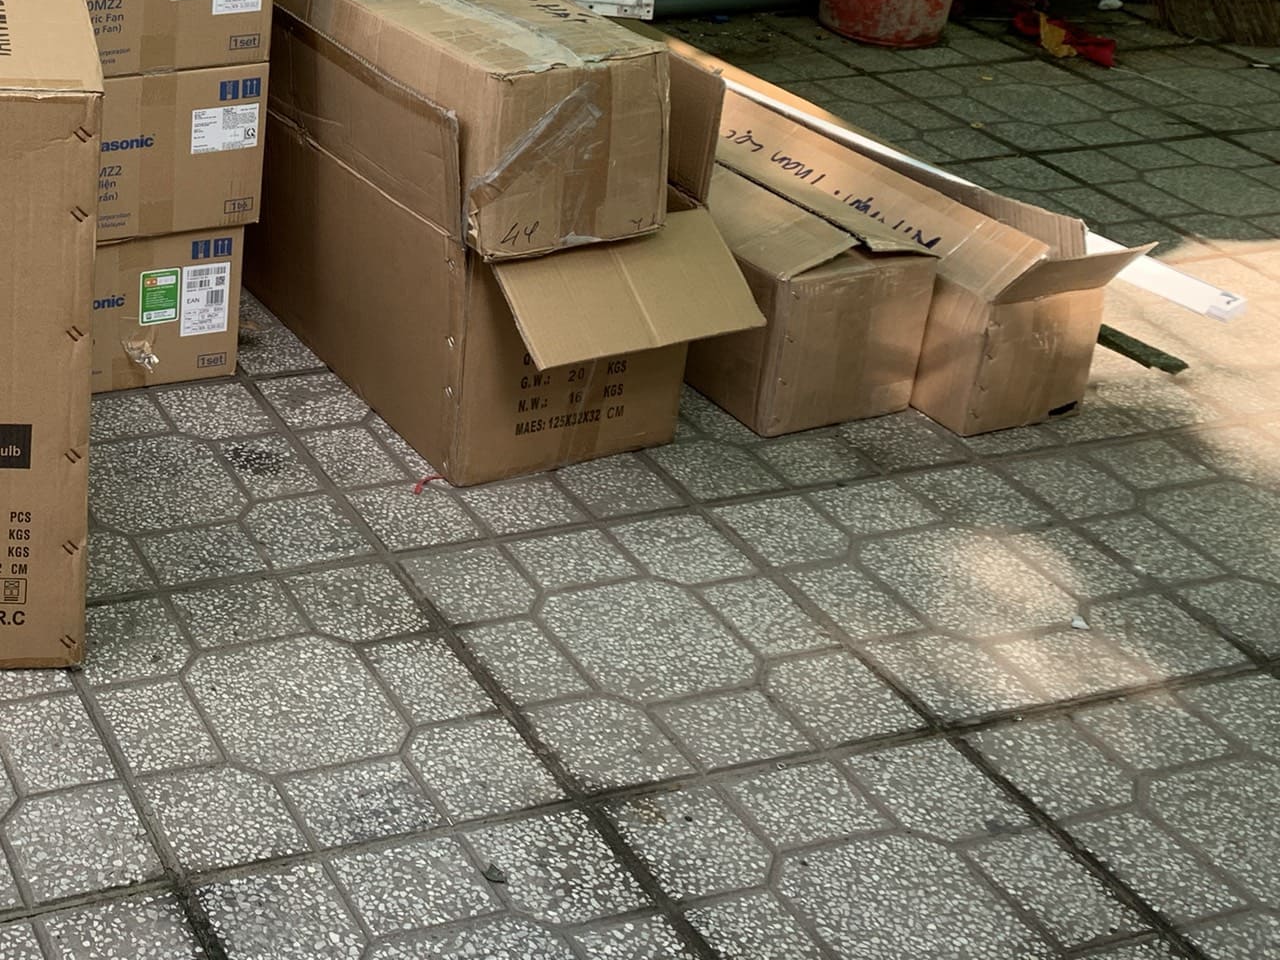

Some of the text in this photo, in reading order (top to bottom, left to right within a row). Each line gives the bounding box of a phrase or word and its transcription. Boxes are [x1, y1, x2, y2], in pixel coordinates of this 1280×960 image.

[106, 14, 124, 23] Fan
[102, 25, 122, 35] Fan)
[101, 134, 155, 153] asonic
[568, 366, 585, 383] 20
[607, 359, 627, 375] KGS
[569, 390, 583, 404] 16
[603, 383, 624, 398] KGS
[514, 420, 546, 436] MAES:
[606, 405, 625, 419] CM
[10, 512, 32, 523] PCS
[8, 529, 31, 541] KGS
[7, 546, 30, 558] KGS
[11, 564, 28, 575] CM
